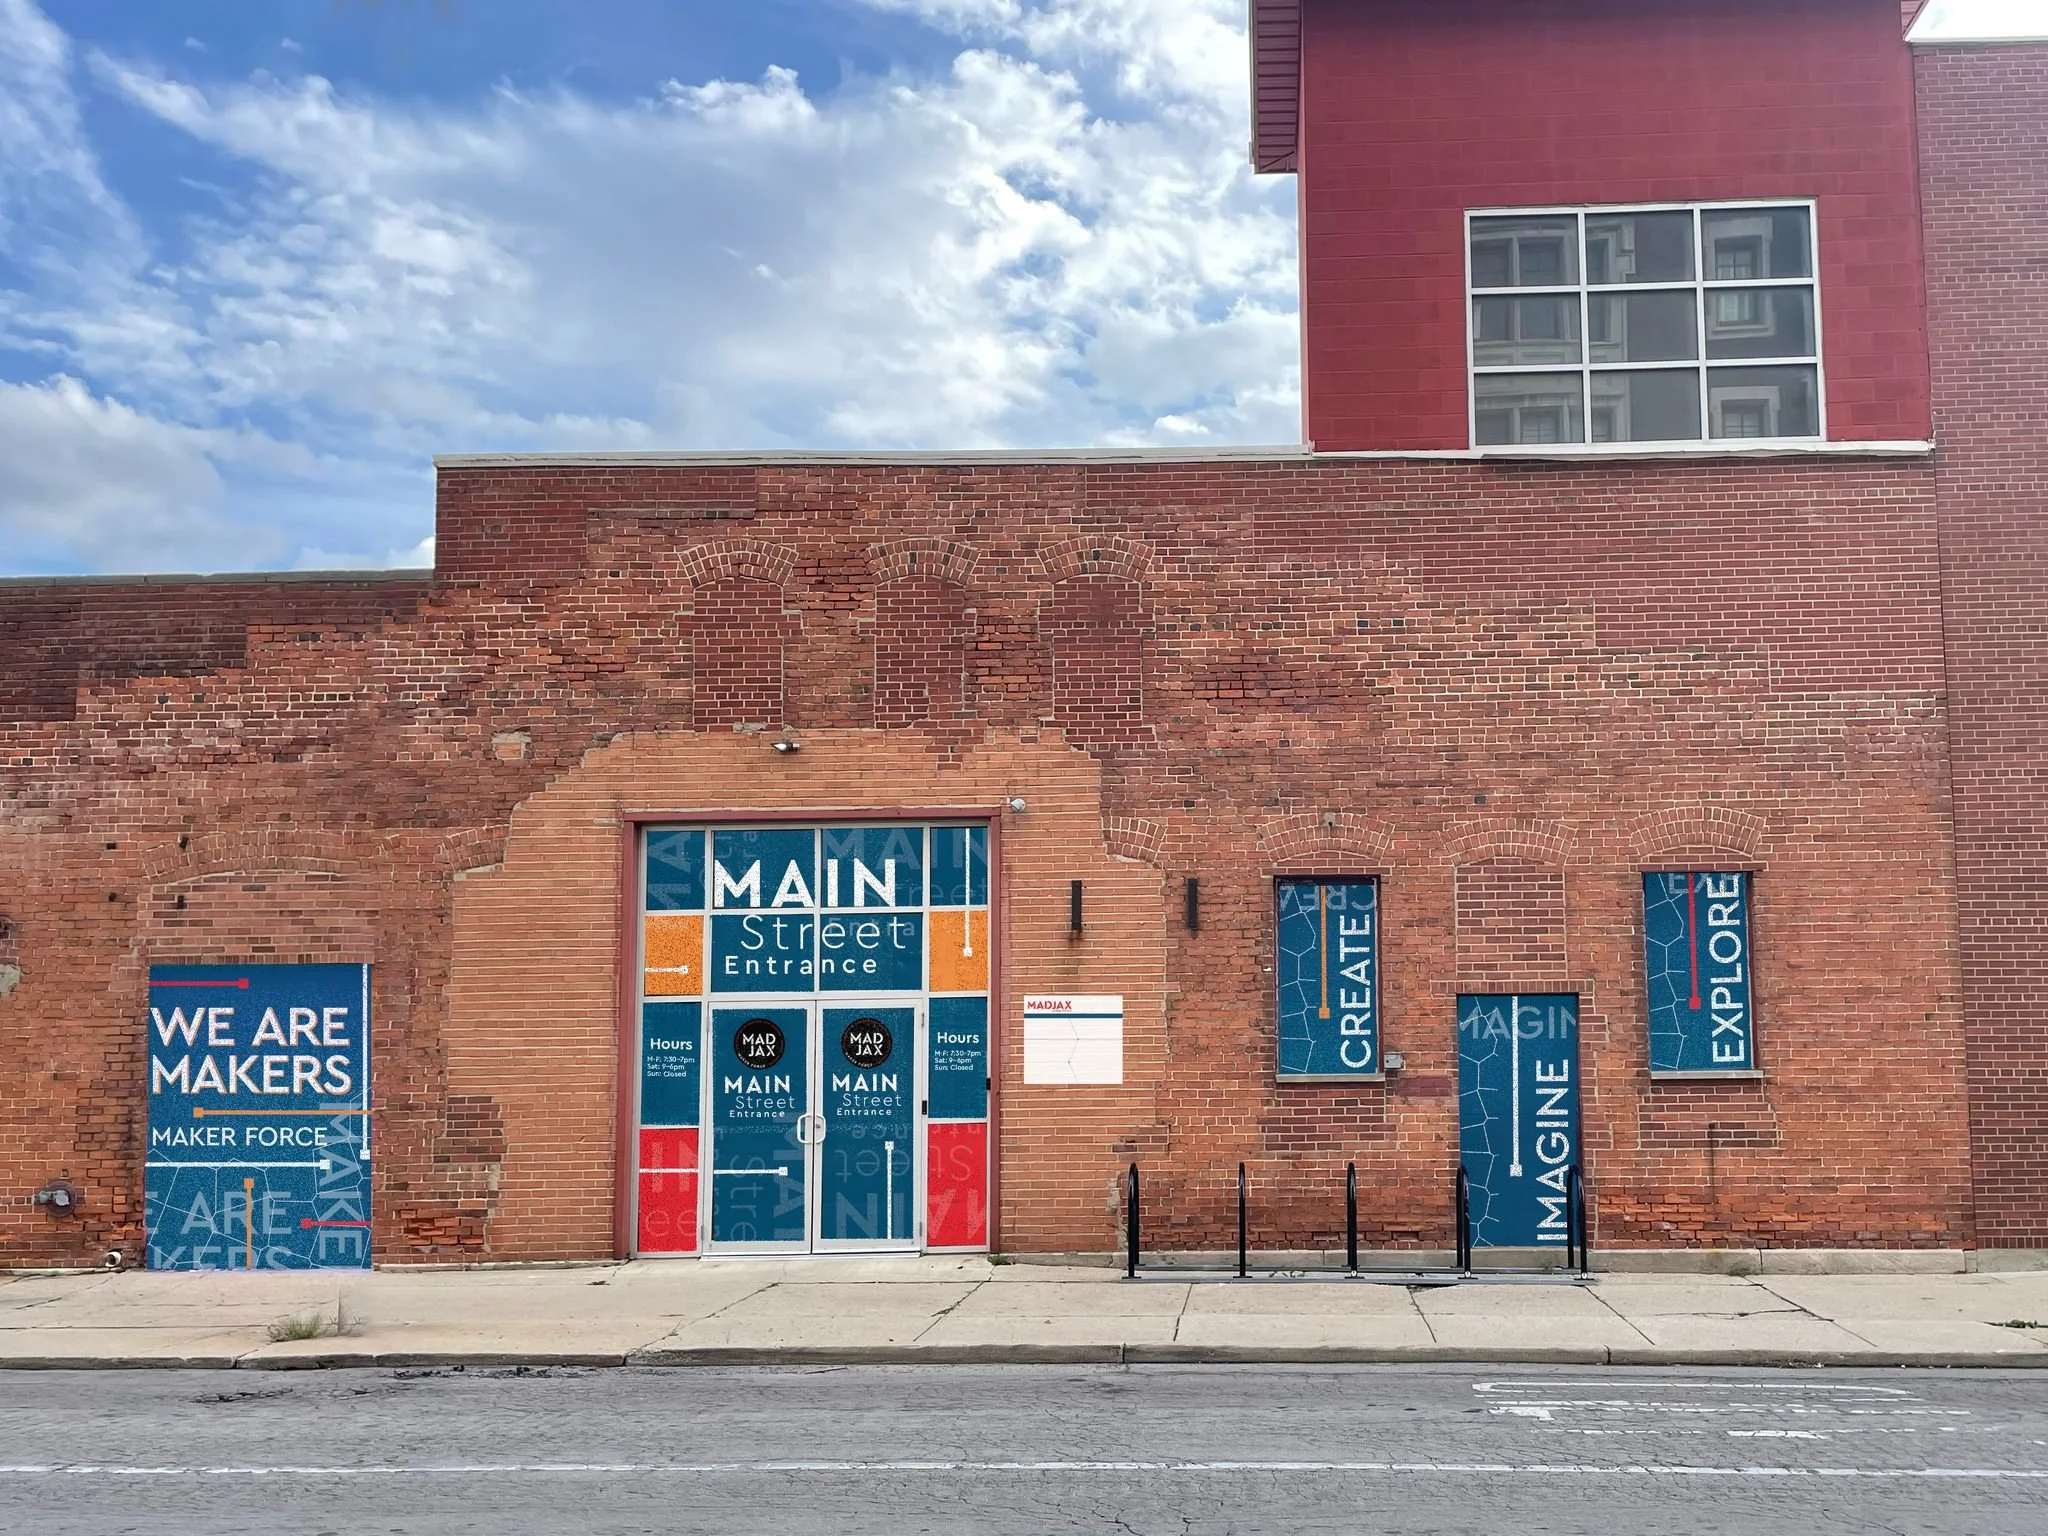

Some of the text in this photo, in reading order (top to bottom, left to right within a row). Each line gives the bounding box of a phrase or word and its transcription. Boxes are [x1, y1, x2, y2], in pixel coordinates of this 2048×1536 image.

[714, 858, 896, 908] MAIN
[741, 914, 906, 950] Street
[725, 956, 877, 975] Entrance
[1707, 874, 1745, 1063] EXPLORE
[1340, 914, 1371, 1069] CREATE
[1027, 1000, 1072, 1010] MADJAX
[150, 1007, 350, 1047] WE ARE
[650, 1038, 693, 1050] Hours
[742, 1033, 776, 1045] MAD
[850, 1032, 884, 1044] MAD
[937, 1031, 980, 1044] Hours
[748, 1044, 776, 1057] JAX
[855, 1044, 883, 1056] JAX
[152, 1054, 351, 1095] MAKERS
[950, 1063, 974, 1071] Closed
[724, 1074, 790, 1094] MAIN
[832, 1073, 897, 1092] MAIN
[735, 1095, 795, 1109] Street
[842, 1093, 902, 1107] Street
[729, 1109, 785, 1118] Entrance
[836, 1107, 892, 1116] Entrance
[152, 1127, 327, 1148] MAKER FORCE
[1536, 1058, 1570, 1241] IMAGINE
[319, 1102, 362, 1269] MAKE
[181, 1191, 292, 1234] ARE
